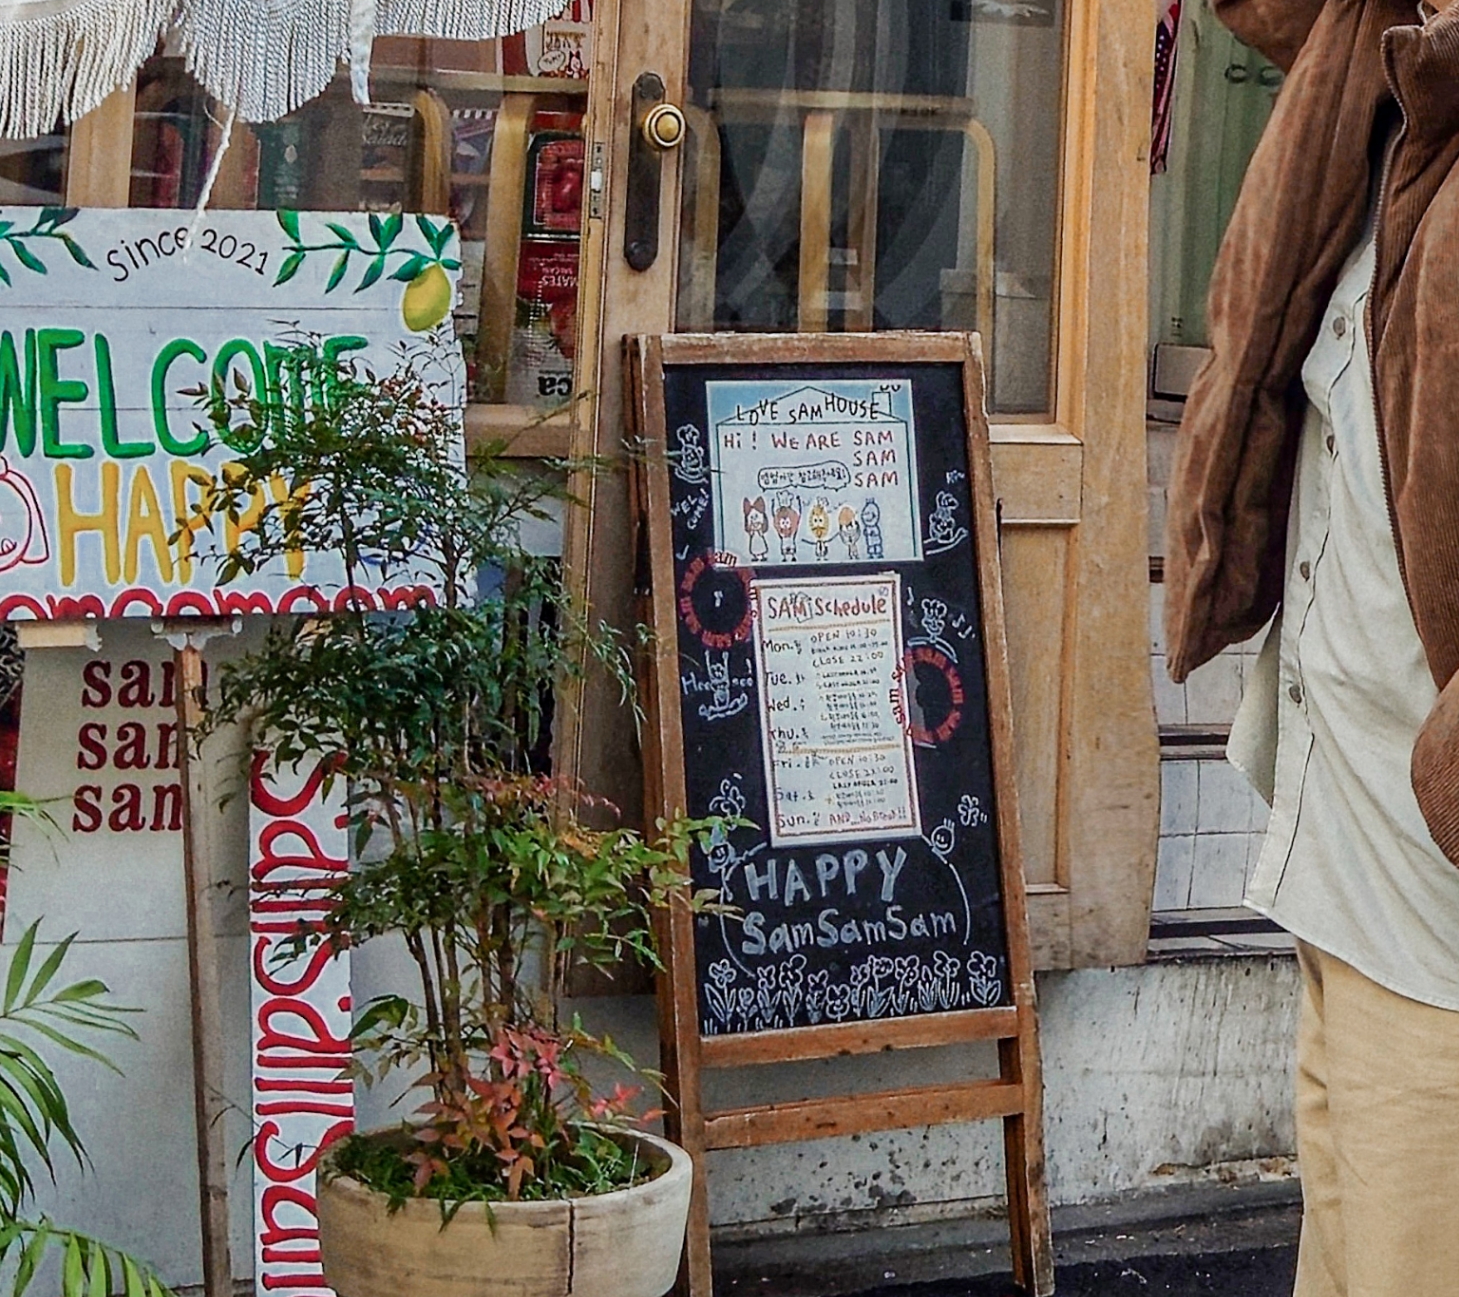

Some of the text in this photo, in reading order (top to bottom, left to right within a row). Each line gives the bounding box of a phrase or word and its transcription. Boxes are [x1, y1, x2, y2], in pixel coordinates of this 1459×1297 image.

[201, 229, 268, 275] 2021
[736, 393, 880, 426] LOVE SAM HOUSE
[724, 432, 742, 449] Hi
[771, 432, 800, 449] WE
[806, 431, 841, 449] ARE
[854, 430, 894, 446] SAM
[853, 450, 896, 467] SAM
[854, 471, 899, 488] SAM
[54, 460, 313, 587] HAPPY
[767, 594, 887, 620] SAM Schedule
[811, 630, 840, 644] OPEN
[813, 656, 845, 668] CLOSE
[743, 845, 908, 907] HAPPY
[741, 904, 957, 955] SamSamSam
